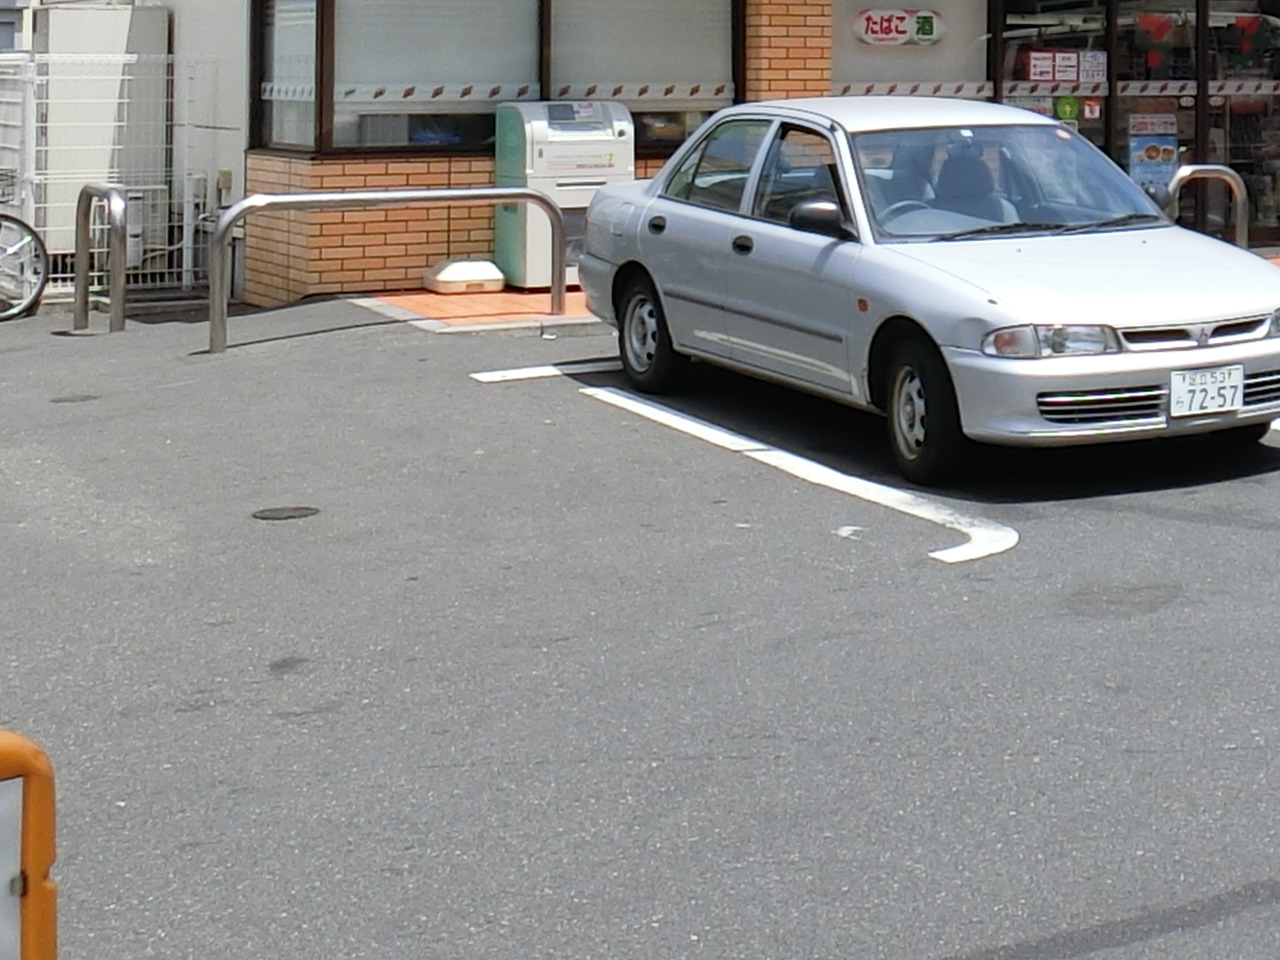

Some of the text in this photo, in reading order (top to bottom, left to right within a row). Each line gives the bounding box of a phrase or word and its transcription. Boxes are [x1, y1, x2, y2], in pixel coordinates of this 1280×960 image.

[864, 14, 935, 36] たばこ 酒
[1187, 384, 1239, 412] 72-57
